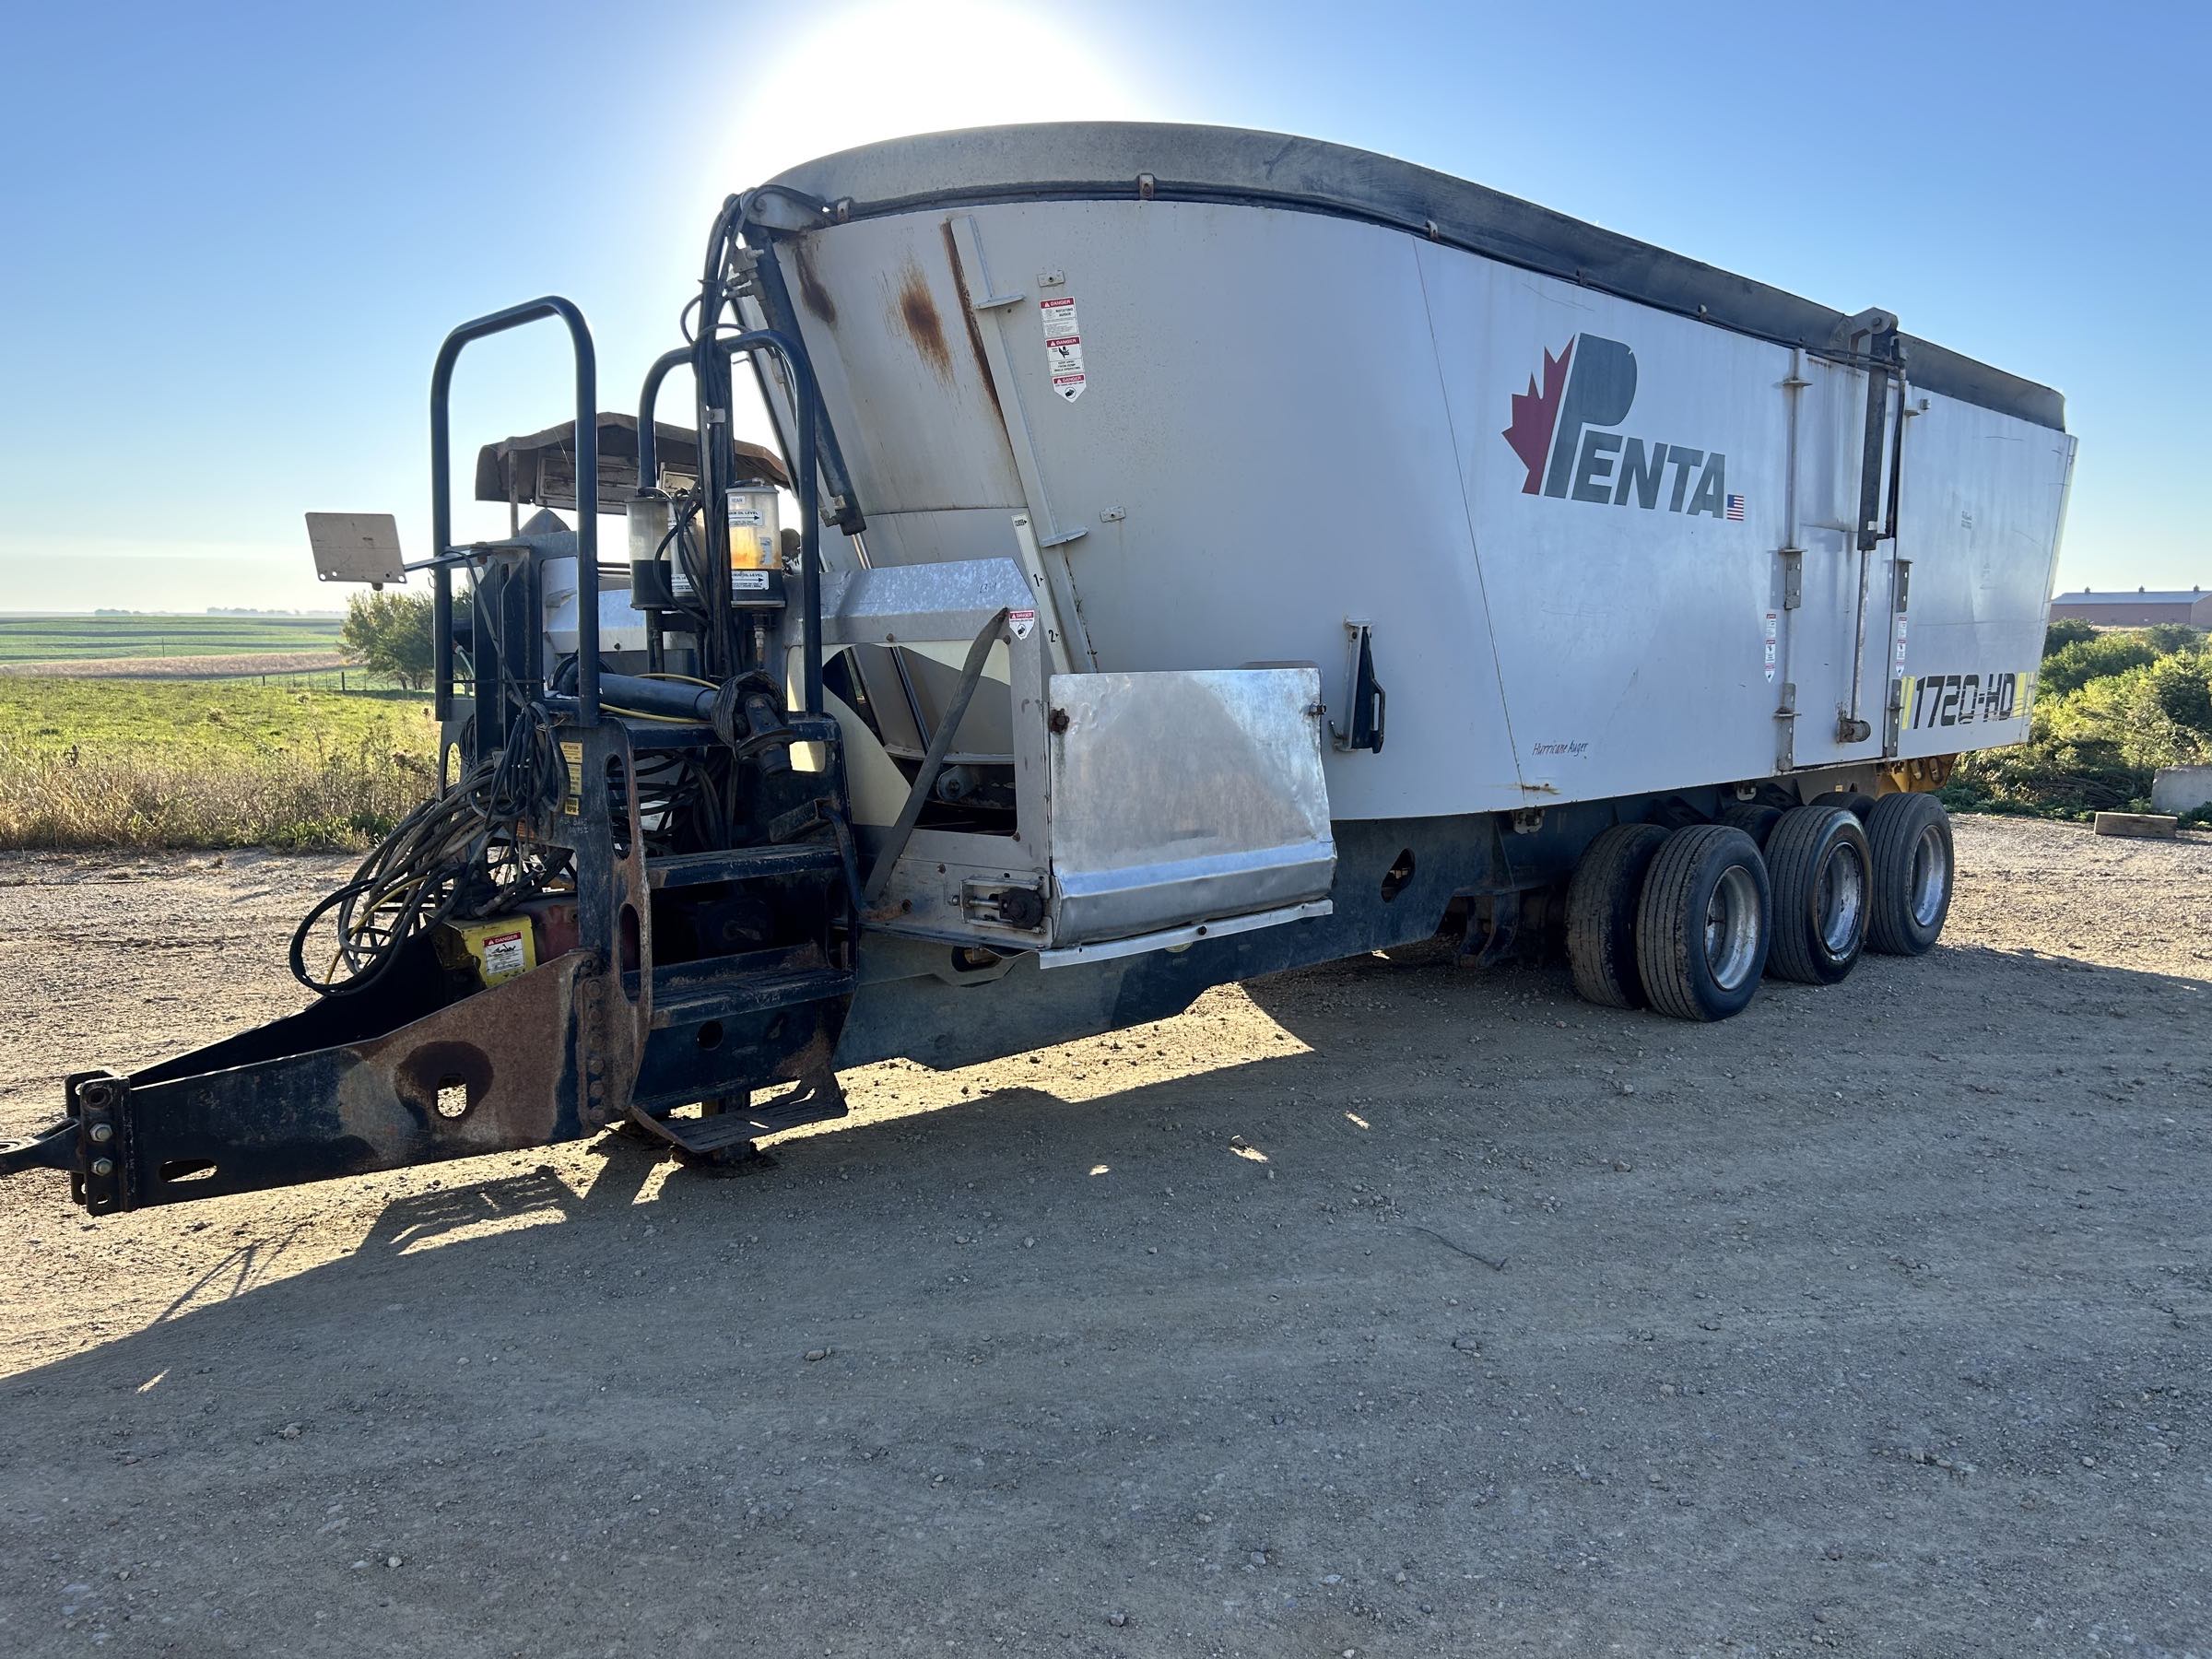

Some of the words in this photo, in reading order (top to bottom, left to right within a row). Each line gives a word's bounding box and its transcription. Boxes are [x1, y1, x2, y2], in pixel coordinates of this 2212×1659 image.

[1544, 333, 1725, 519] PENTA
[1033, 573, 1041, 587] 1
[1048, 629, 1056, 642] 2
[1912, 673, 2017, 729] 1720-HD
[1532, 742, 1569, 757] Hurricane
[1568, 740, 1589, 757] Auger
[495, 935, 518, 944] DANGER
